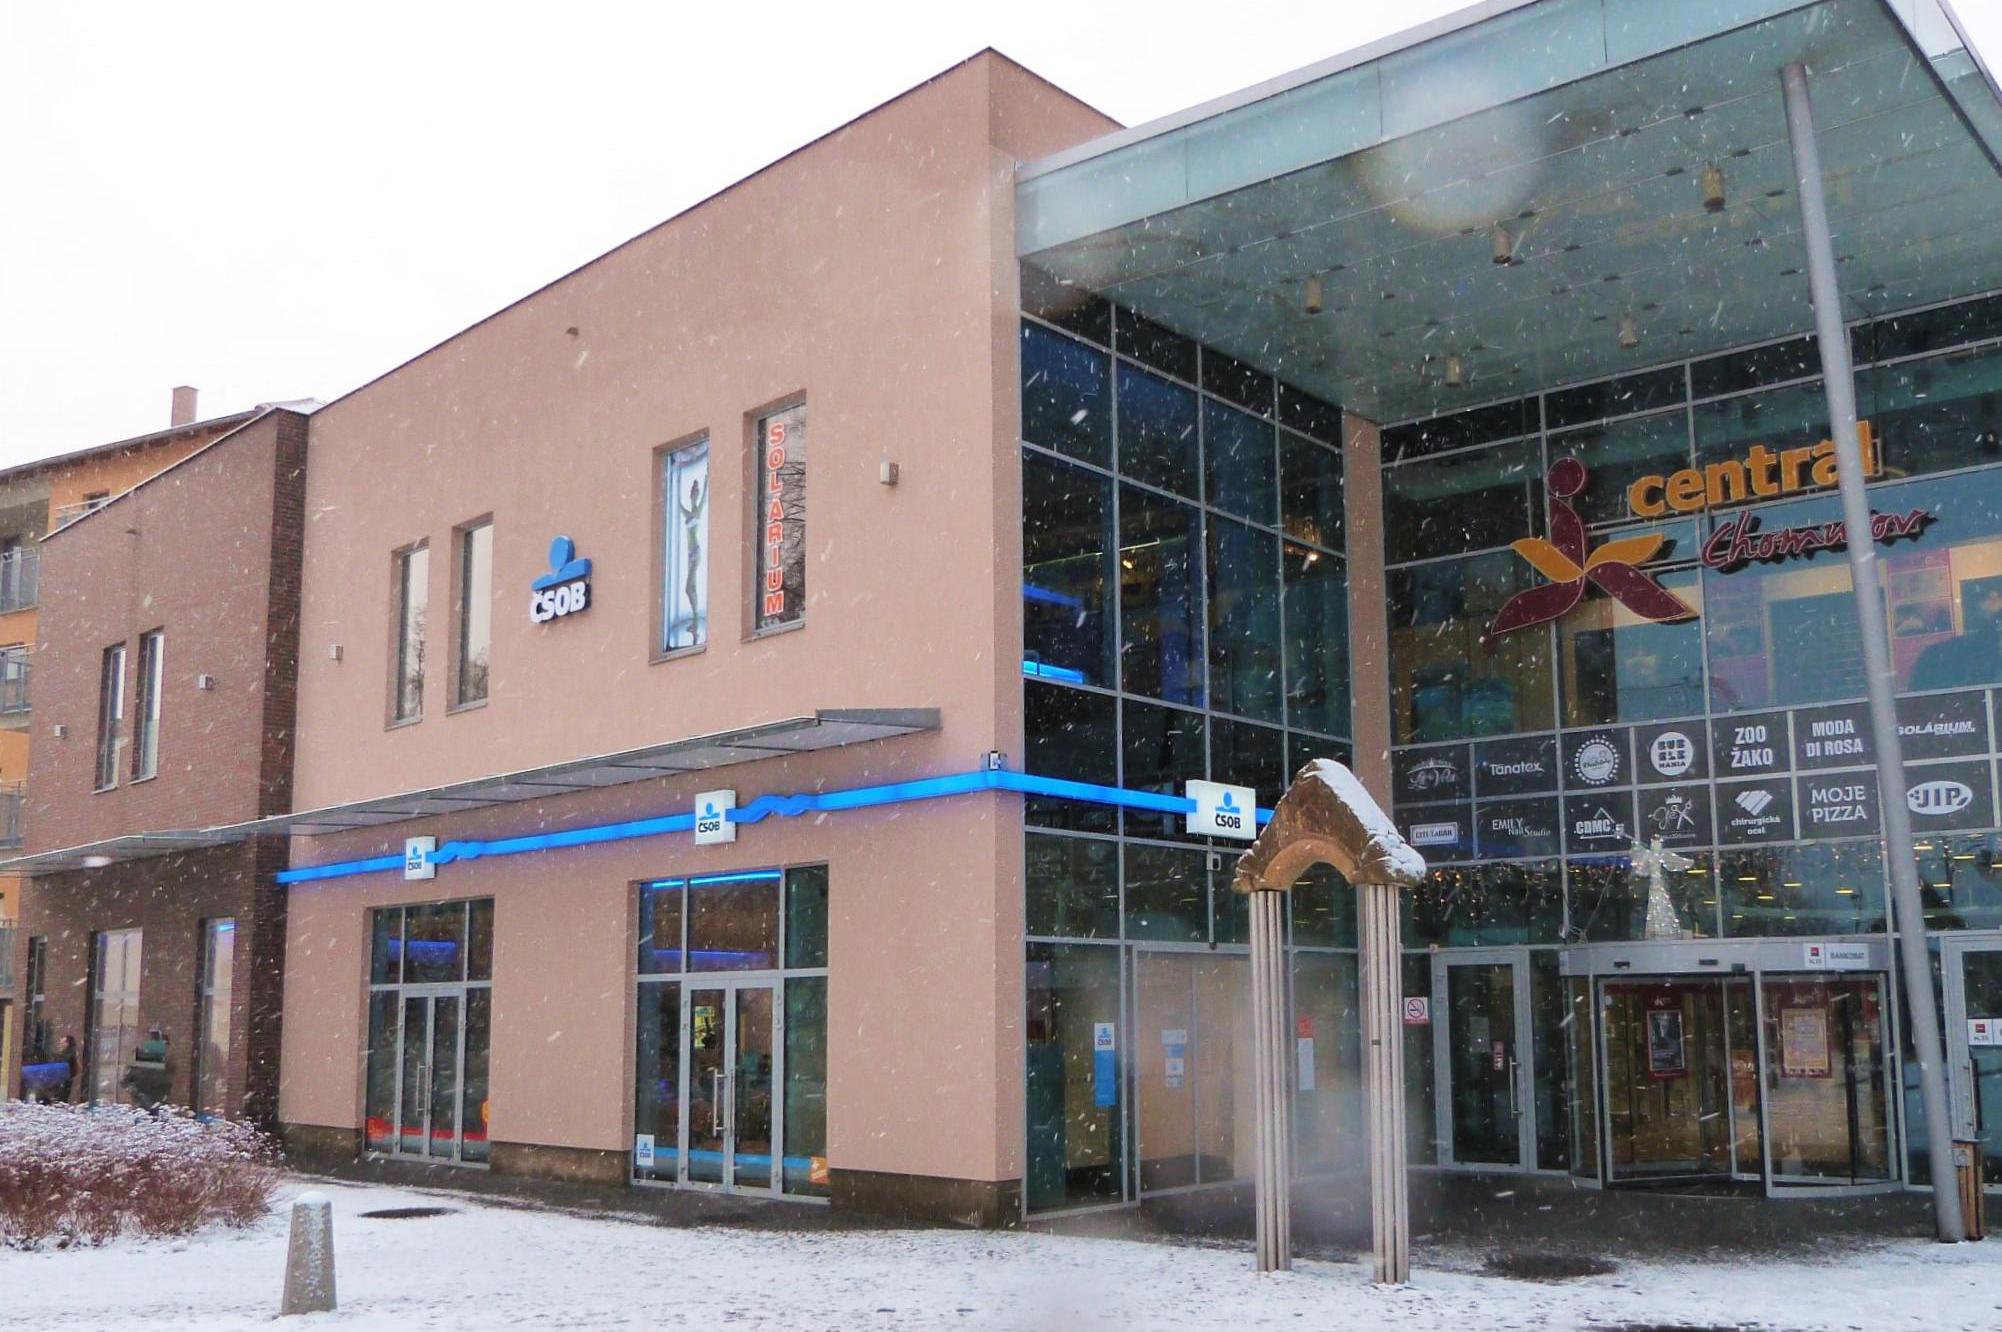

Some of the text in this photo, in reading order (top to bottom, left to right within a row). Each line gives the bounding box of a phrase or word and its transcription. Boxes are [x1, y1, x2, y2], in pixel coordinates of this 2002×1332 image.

[1629, 419, 1874, 518] central
[764, 421, 787, 616] SOLARIUM
[1702, 509, 1930, 569] Chomuov
[1734, 725, 1767, 745] ZOO
[1812, 719, 1855, 737] MODA
[1806, 738, 1863, 757] DI ROSA
[1730, 747, 1773, 768] ŽAKO
[1490, 761, 1544, 776] Tanatex
[1811, 785, 1867, 804] MOJE
[1917, 787, 1961, 808] JIP
[1812, 805, 1867, 823] PIZZA
[1492, 817, 1523, 831] EMILY
